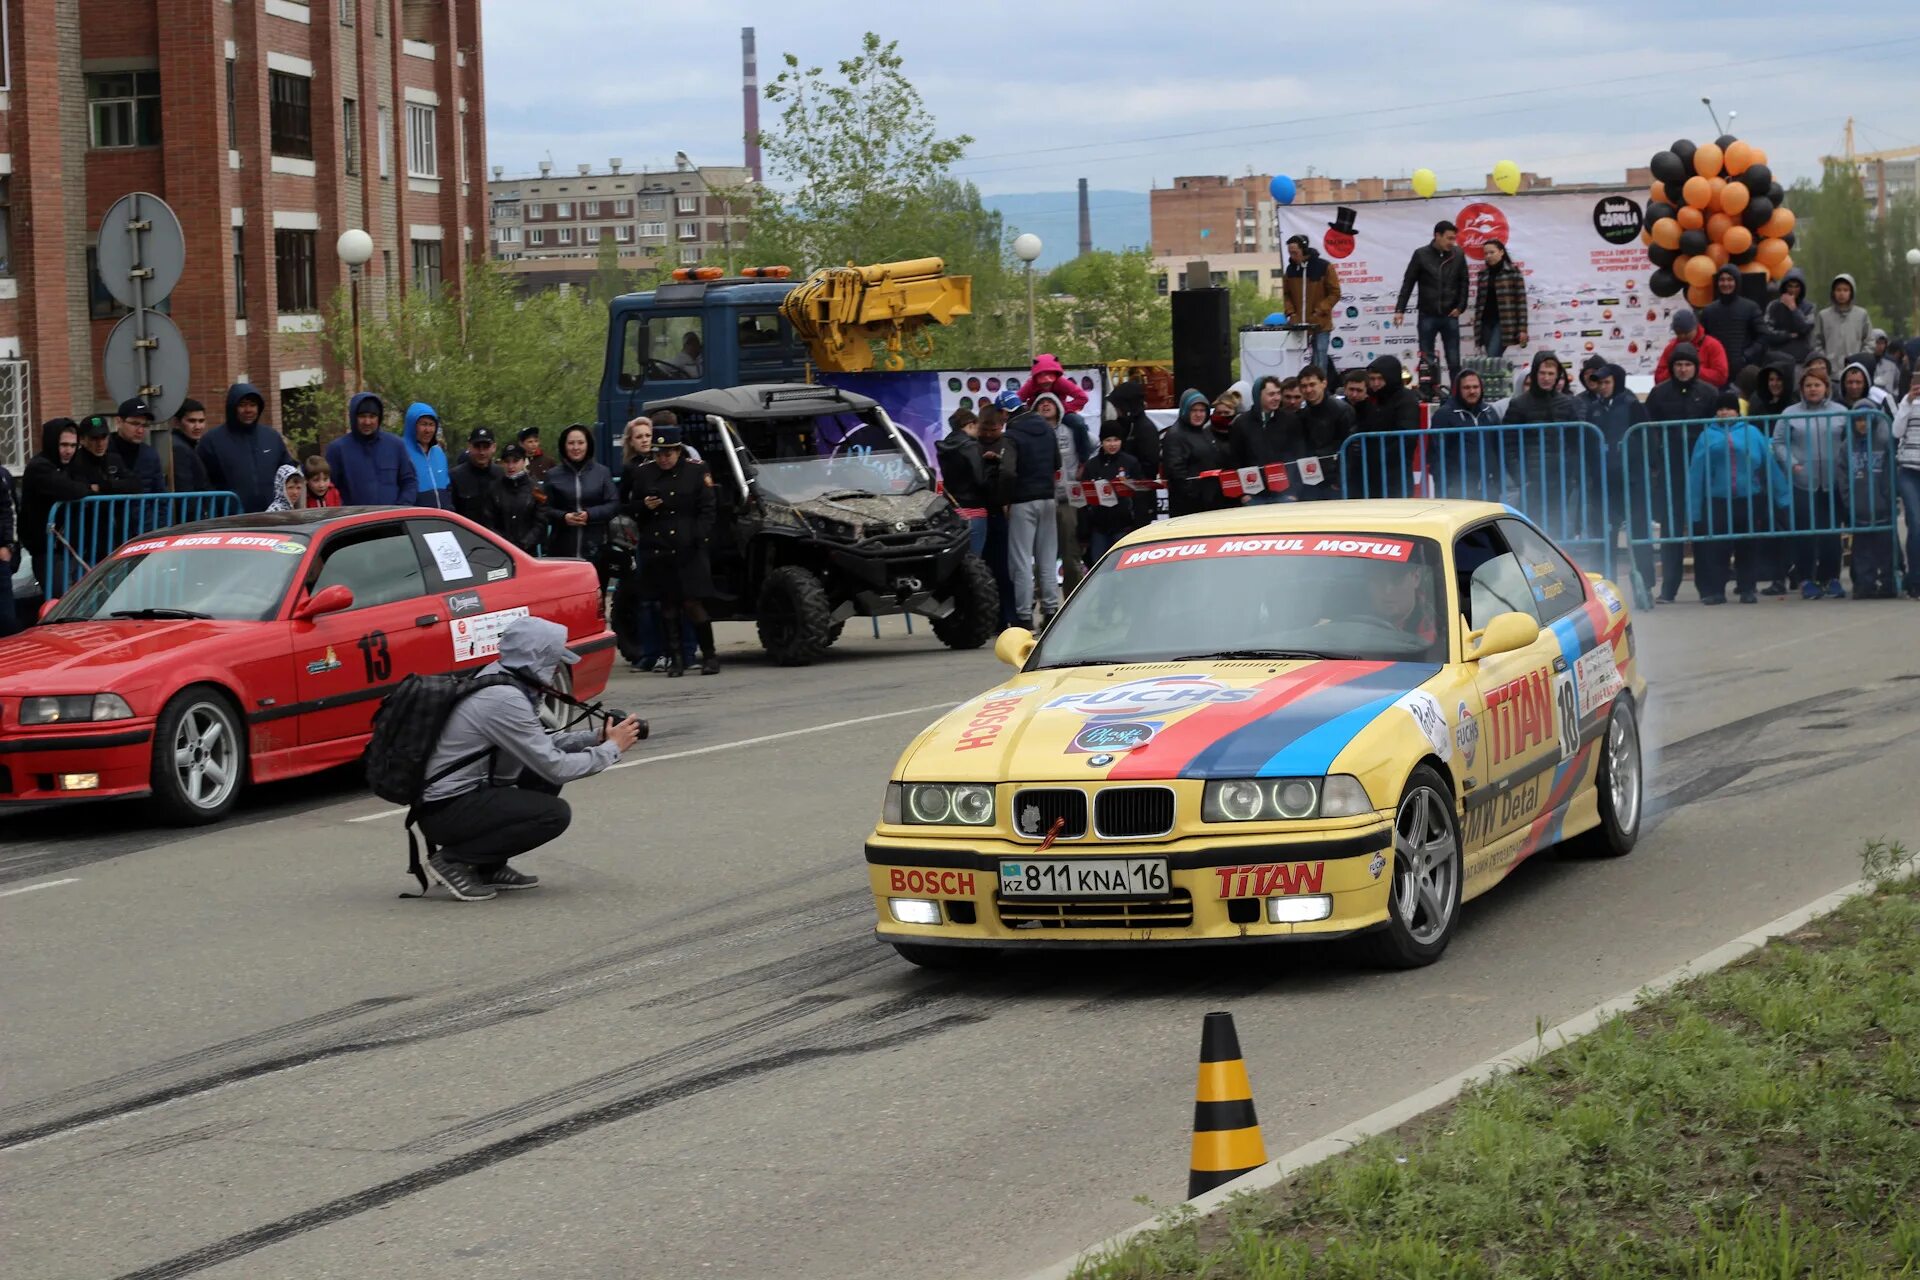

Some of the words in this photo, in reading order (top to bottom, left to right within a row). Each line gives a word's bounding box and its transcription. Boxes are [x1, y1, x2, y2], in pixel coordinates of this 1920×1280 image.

[1599, 212, 1639, 227] GORILLA
[120, 540, 168, 555] MOTUL
[171, 536, 223, 547] MOTUL
[227, 536, 279, 547] MOTUL
[1124, 543, 1207, 565] MOTUL
[1217, 540, 1304, 552] MOTUL
[1312, 540, 1402, 557] MOTUL
[357, 630, 391, 683] 13
[1044, 688, 1254, 709] FUCHS
[954, 697, 1021, 752] BOSCH
[1558, 681, 1579, 755] 18
[1456, 721, 1479, 748] FUCHS
[1501, 774, 1540, 828] Detal
[1003, 879, 1024, 892] KZ
[1025, 864, 1072, 892] 811
[1078, 869, 1127, 892] KNA
[1132, 863, 1165, 890] 16
[1369, 857, 1386, 872] FUCHS
[890, 868, 976, 896] BOSCH
